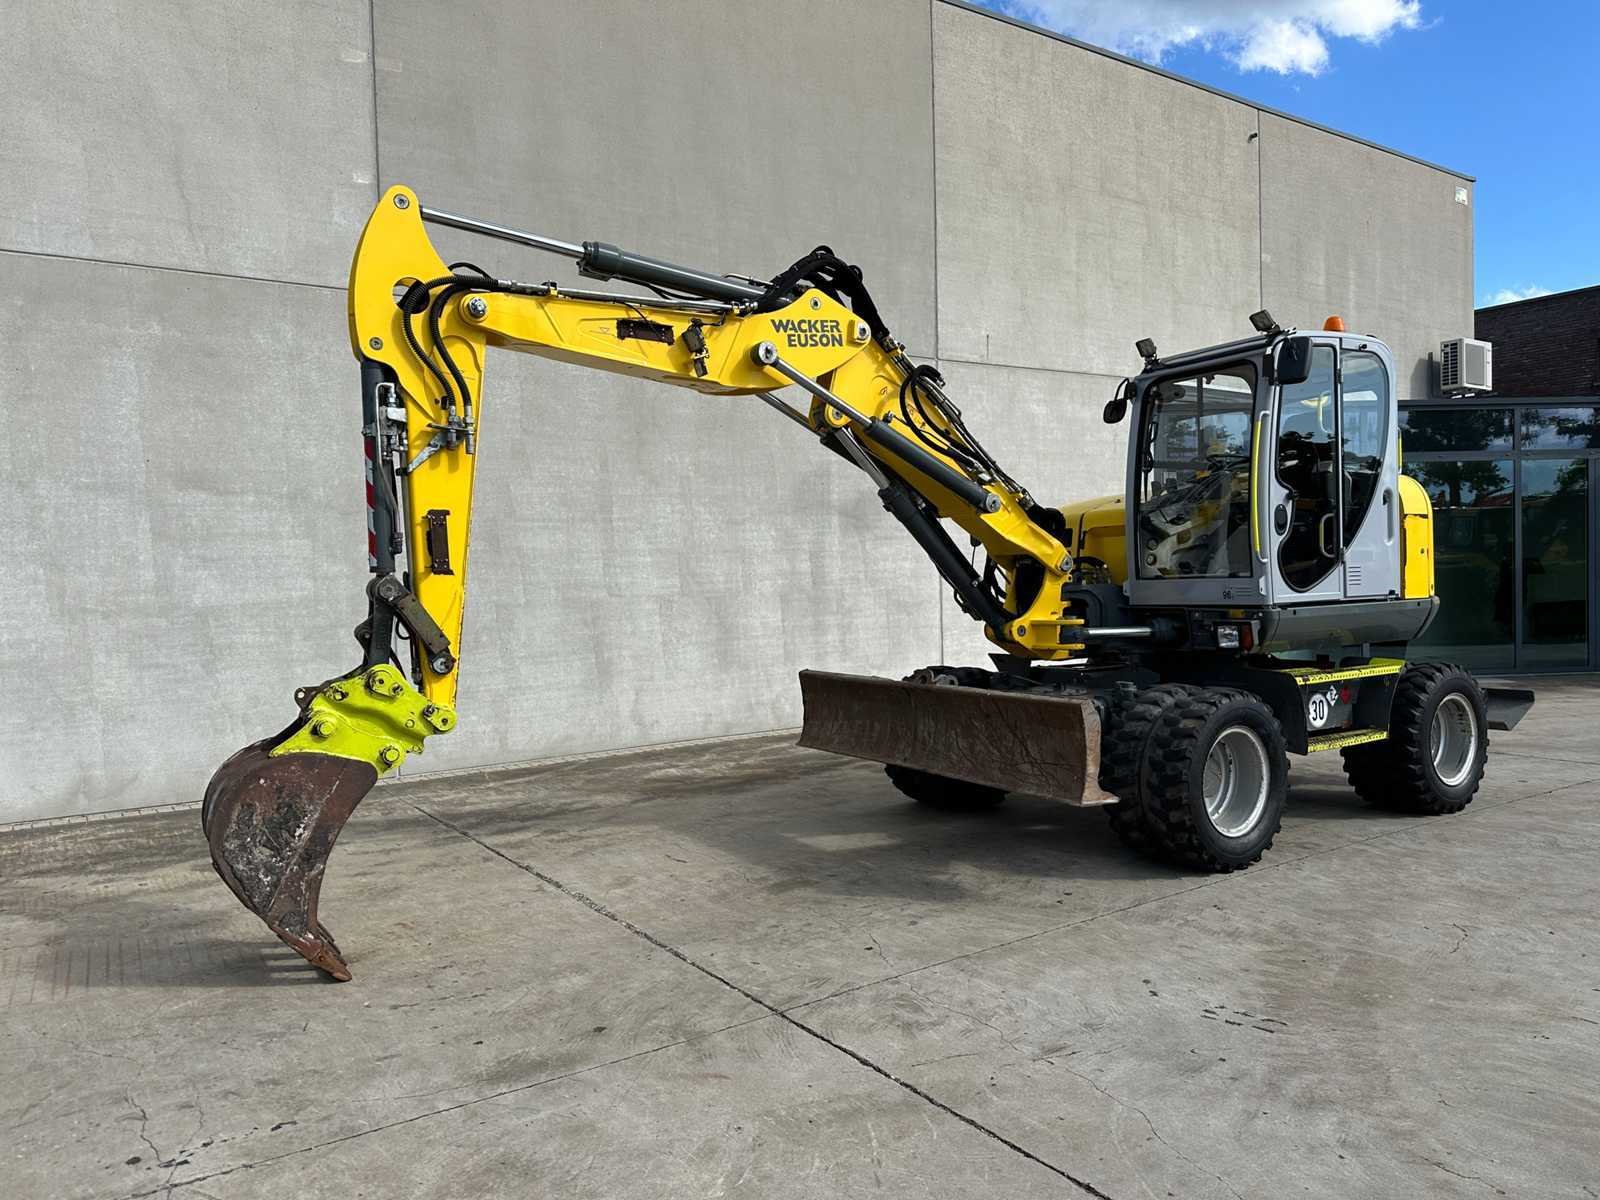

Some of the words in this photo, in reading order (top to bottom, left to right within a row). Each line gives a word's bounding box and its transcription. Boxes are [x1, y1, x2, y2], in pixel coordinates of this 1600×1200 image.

[770, 319, 842, 333] WACKER
[787, 333, 843, 347] EUSON
[1311, 700, 1325, 721] 30
